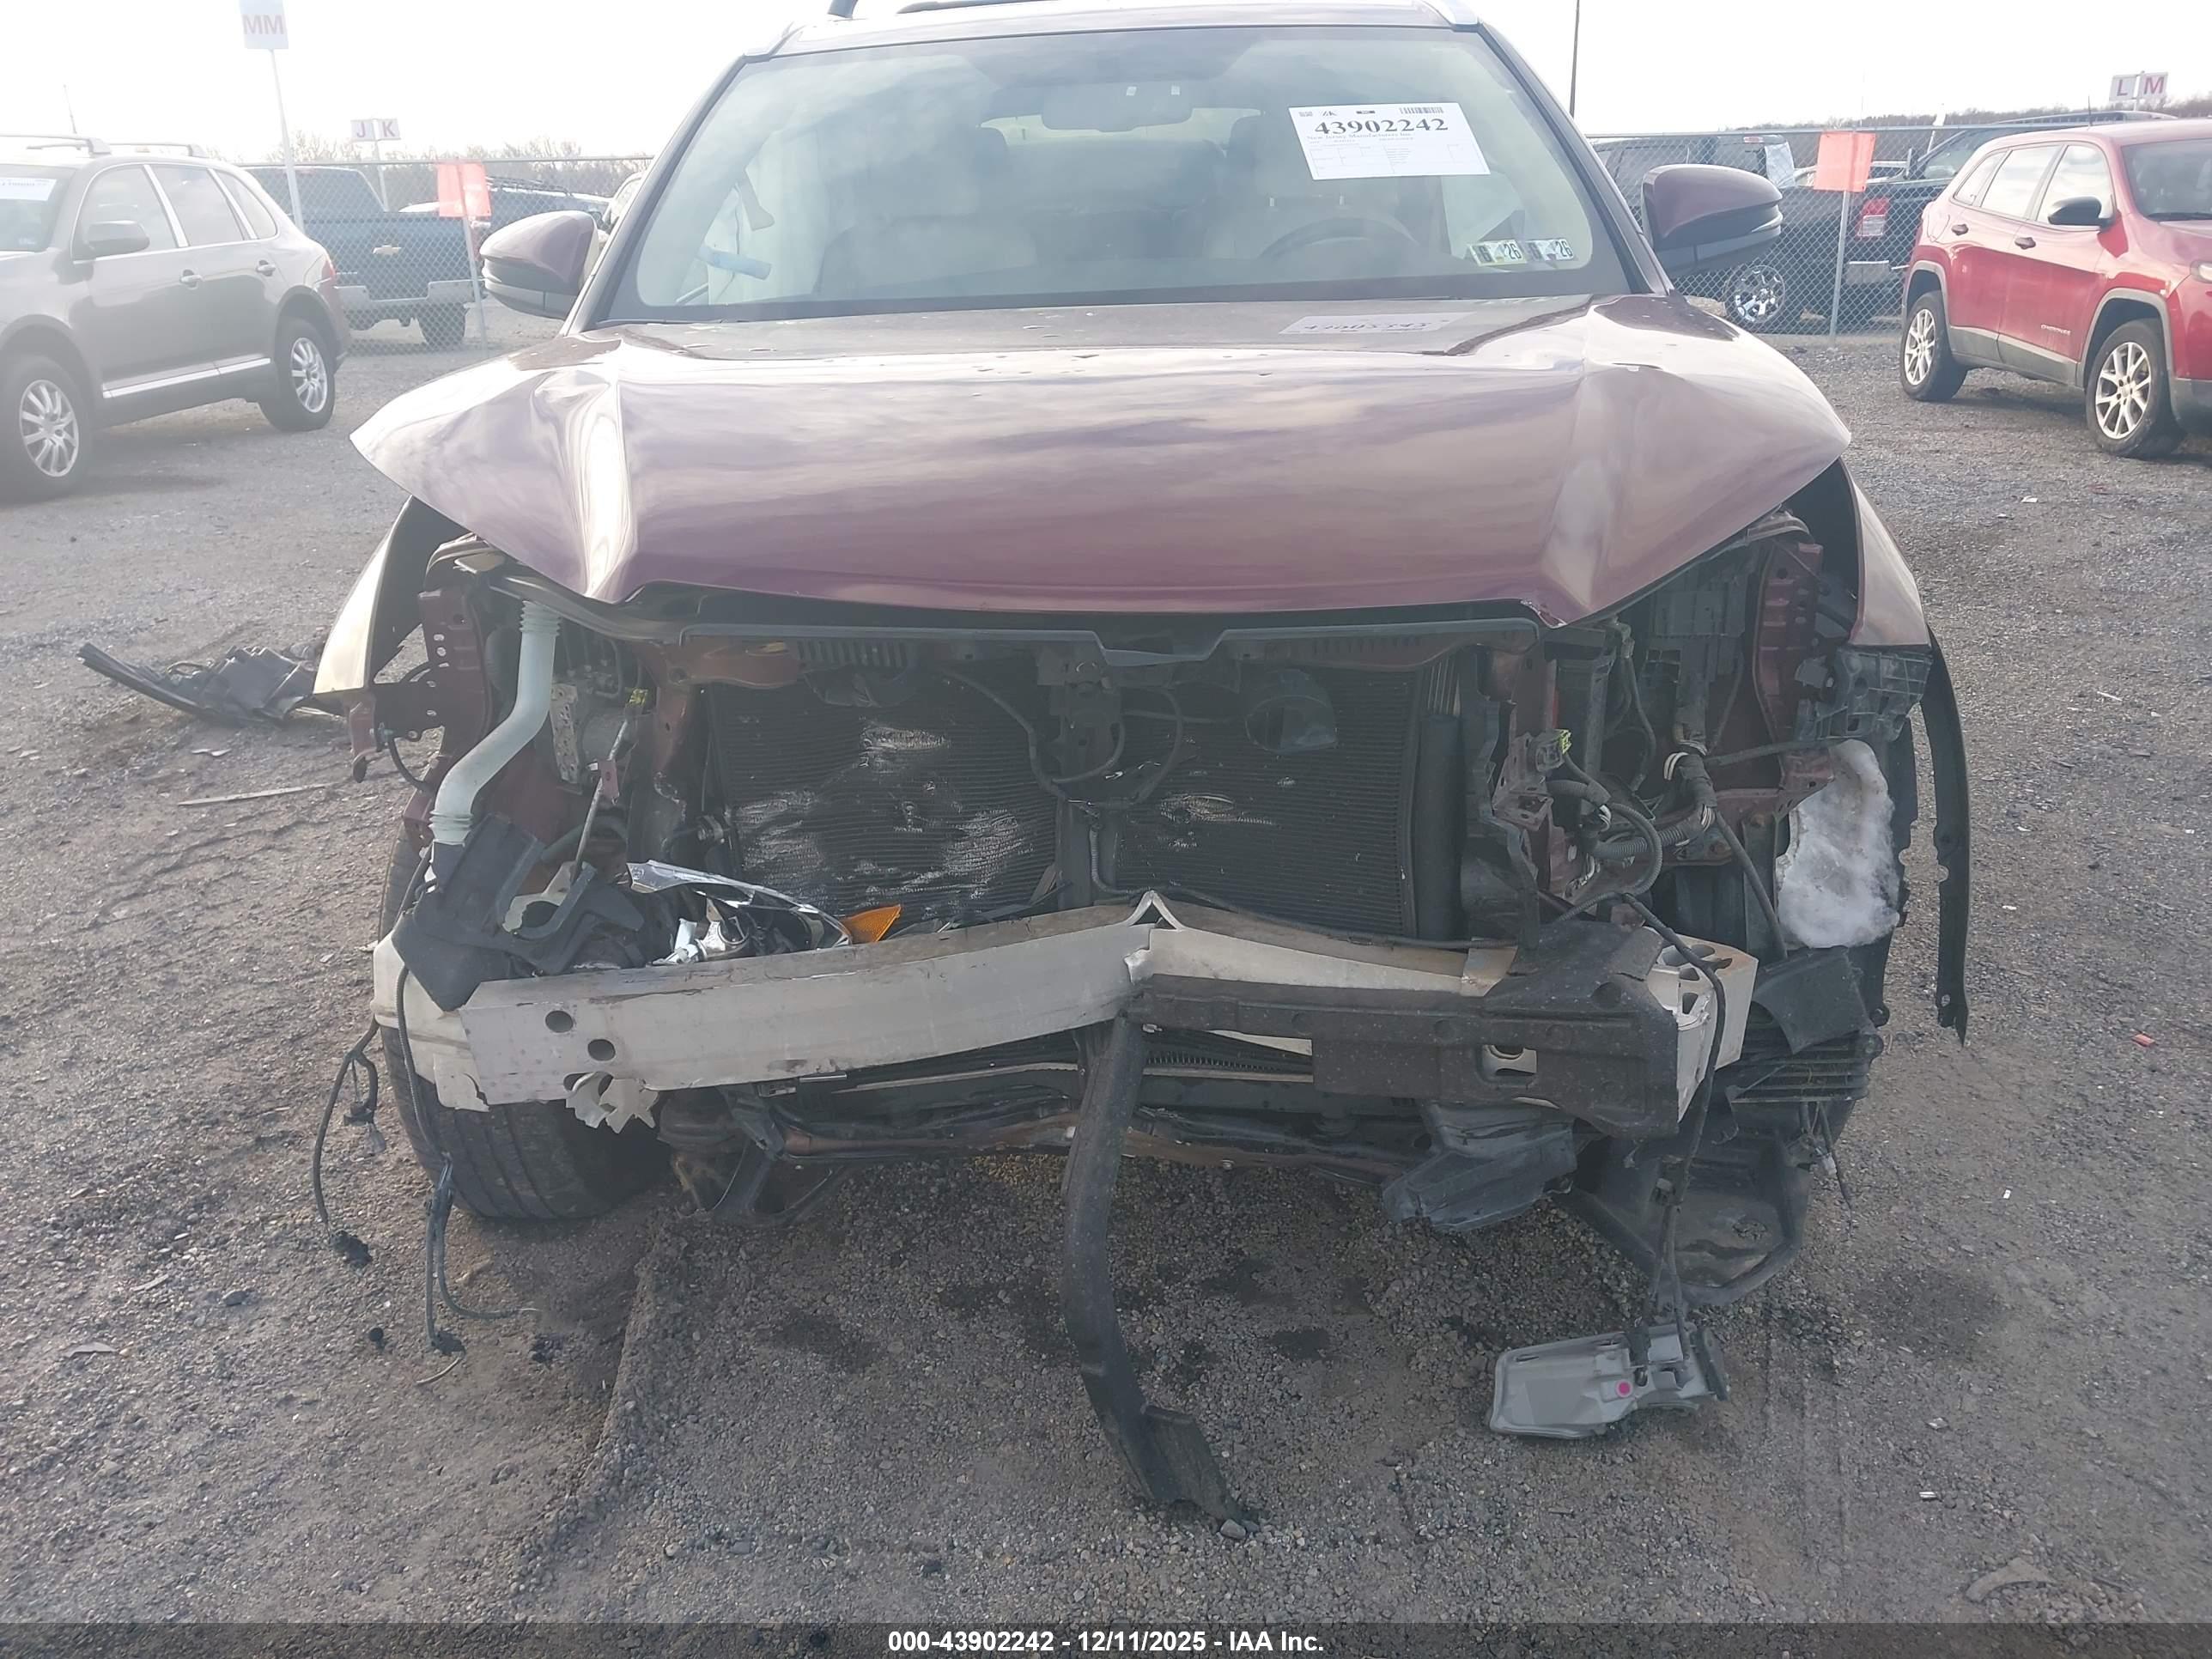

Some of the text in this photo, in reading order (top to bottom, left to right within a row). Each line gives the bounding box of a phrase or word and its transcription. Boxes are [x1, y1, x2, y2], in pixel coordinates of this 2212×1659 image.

[242, 15, 284, 34] MM
[2116, 79, 2129, 96] L
[2143, 76, 2165, 95] M
[356, 121, 367, 138] J
[382, 121, 396, 137] K
[1315, 118, 1448, 135] 43902242
[1504, 243, 1522, 260] 26
[1555, 240, 1573, 258] 26
